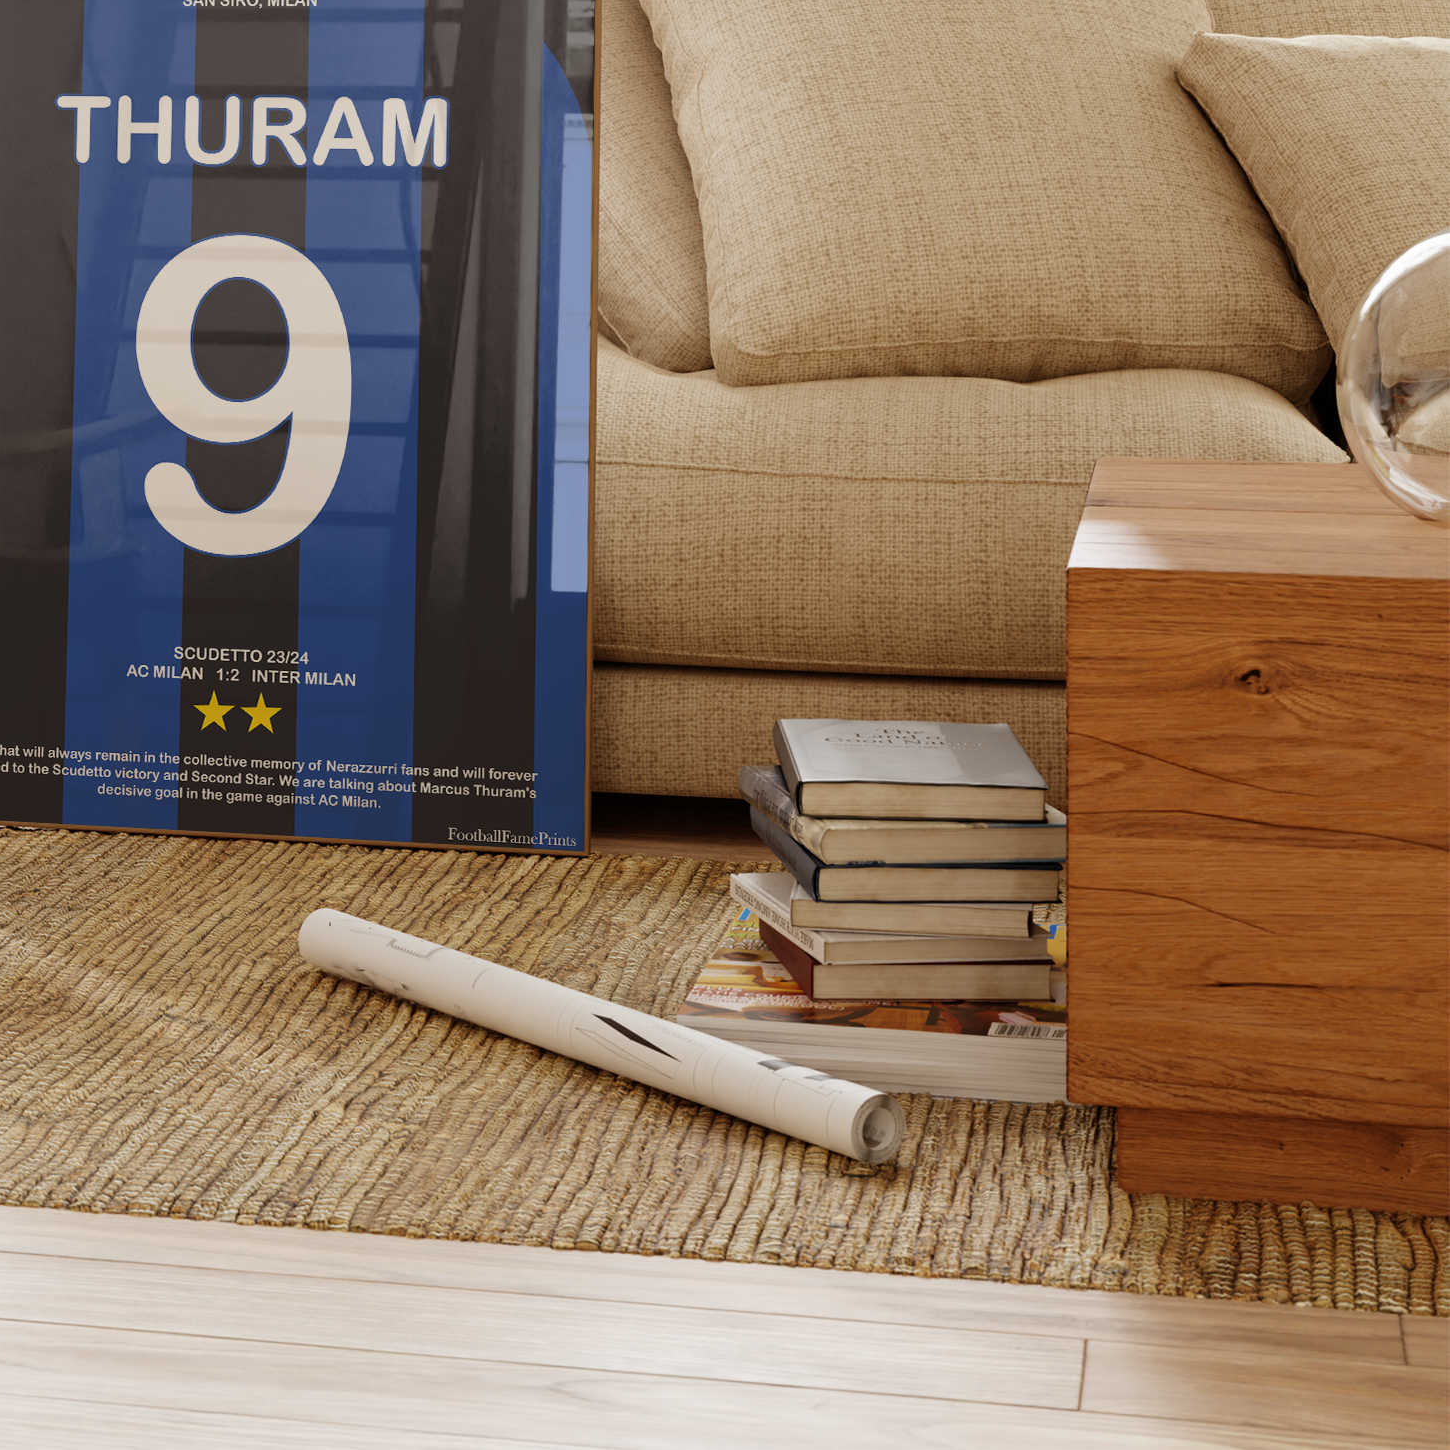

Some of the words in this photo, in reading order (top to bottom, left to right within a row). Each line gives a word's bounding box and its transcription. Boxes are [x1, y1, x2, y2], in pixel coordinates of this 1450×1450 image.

[56, 94, 448, 168] THURAM
[135, 234, 352, 556] 9
[173, 645, 263, 663] SCUDETTO
[266, 649, 310, 665] 23/24
[126, 663, 150, 678] AC
[153, 664, 204, 681] MILAN
[215, 667, 240, 682] 1:2
[251, 669, 301, 685] INTER
[304, 671, 356, 687] MILAN
[22, 745, 45, 758] will
[47, 746, 92, 763] always
[95, 750, 141, 763] remain
[143, 750, 156, 764] in
[158, 751, 181, 765] the
[183, 753, 248, 768] collective
[250, 759, 306, 774] memory
[307, 759, 323, 772] of
[325, 759, 398, 776] Nerazzurri
[400, 763, 430, 777] fans
[432, 765, 459, 778] and
[461, 766, 485, 780] will
[487, 767, 539, 782] forever
[12, 761, 26, 774] to
[27, 762, 50, 775] the
[52, 763, 112, 778] Scudetto
[114, 766, 161, 783] victory
[163, 769, 189, 782] and
[191, 769, 242, 785] Second
[244, 772, 276, 786] Star.
[278, 774, 300, 788] We
[302, 778, 326, 789] are
[328, 777, 374, 794] talking
[377, 779, 418, 793] about
[419, 781, 471, 796] Marcus
[472, 784, 537, 799] Thuram's
[97, 782, 152, 798] decisive
[154, 786, 184, 801] goal
[186, 787, 199, 800] in
[201, 787, 224, 801] the
[225, 792, 263, 805] game
[265, 792, 316, 807] against
[318, 793, 339, 807] AC
[341, 794, 382, 809] Milan.
[447, 826, 577, 847] FootballFamePrints
[734, 884, 754, 908] FRIENDS
[753, 897, 771, 918] AMONG
[771, 910, 786, 930] HOME
[786, 921, 800, 941] YOUR
[800, 931, 815, 951] MAKE
